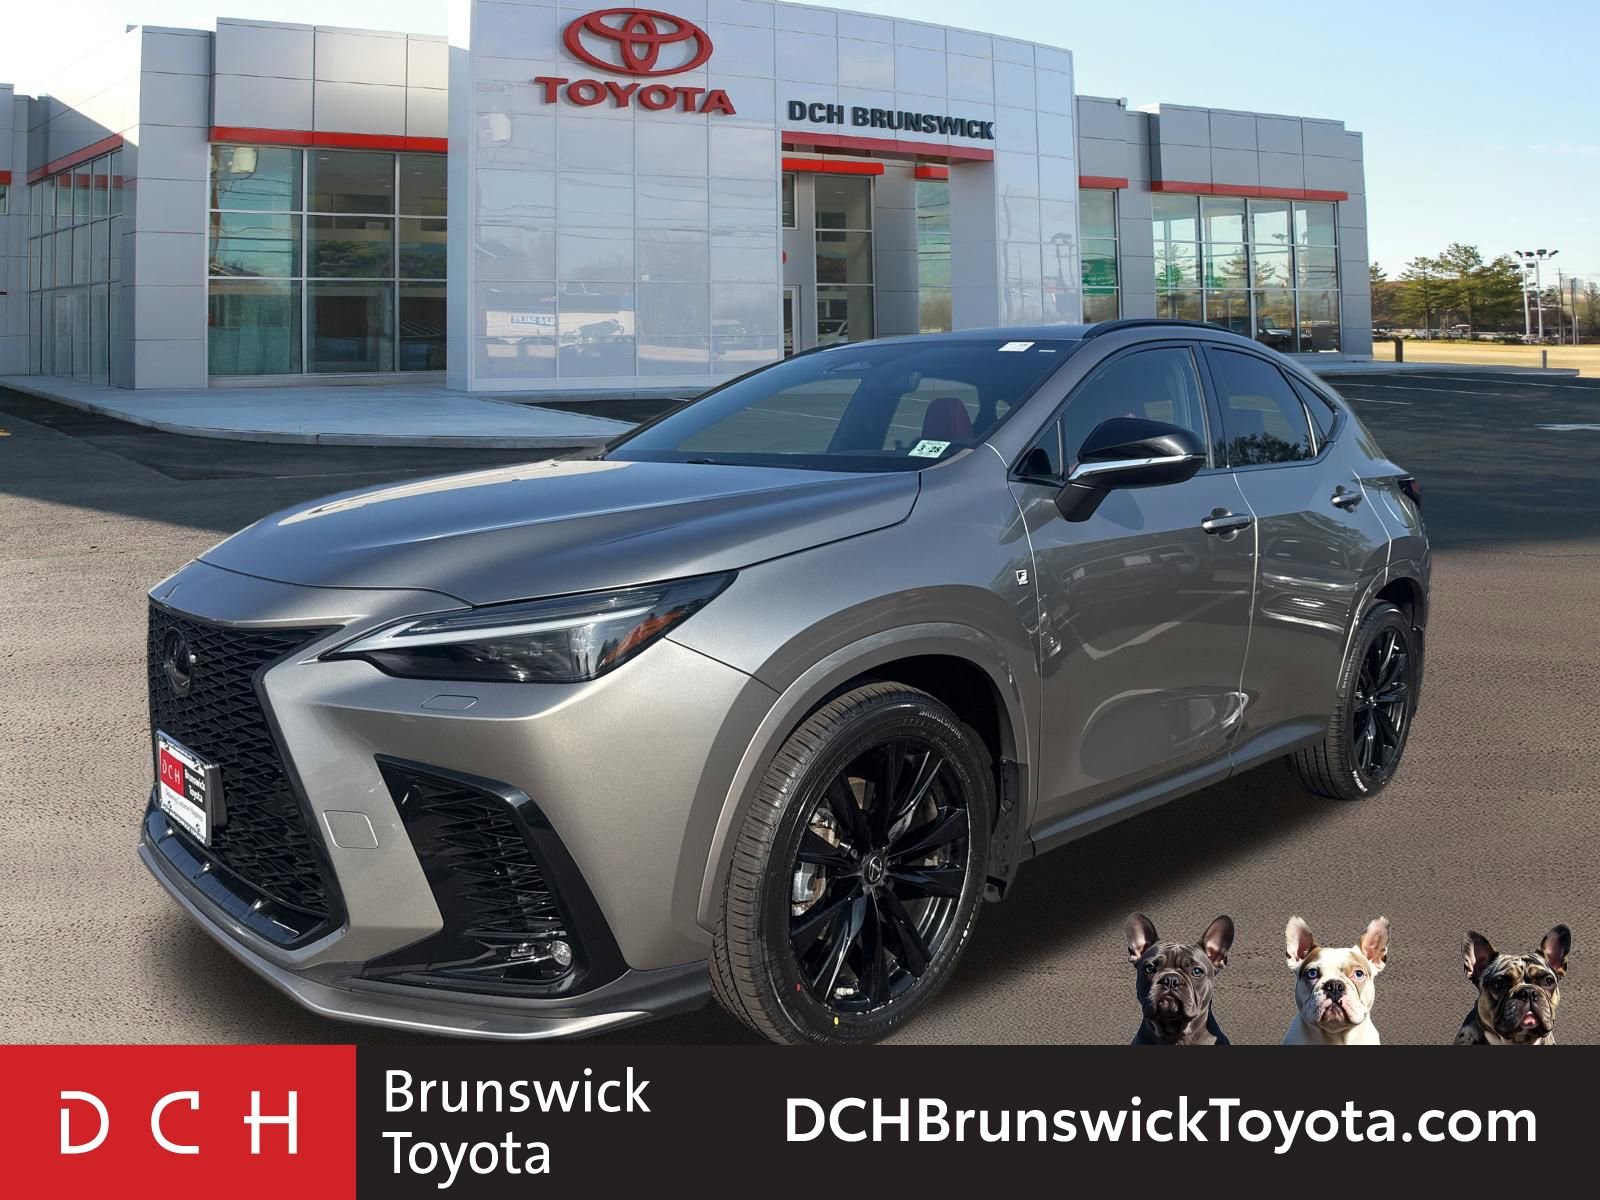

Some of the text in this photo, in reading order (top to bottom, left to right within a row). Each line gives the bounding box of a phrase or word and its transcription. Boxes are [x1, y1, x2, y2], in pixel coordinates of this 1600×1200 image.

[534, 76, 737, 115] TOYOTA
[788, 100, 995, 140] DCH BRUNSWICK
[161, 759, 181, 785] DCH
